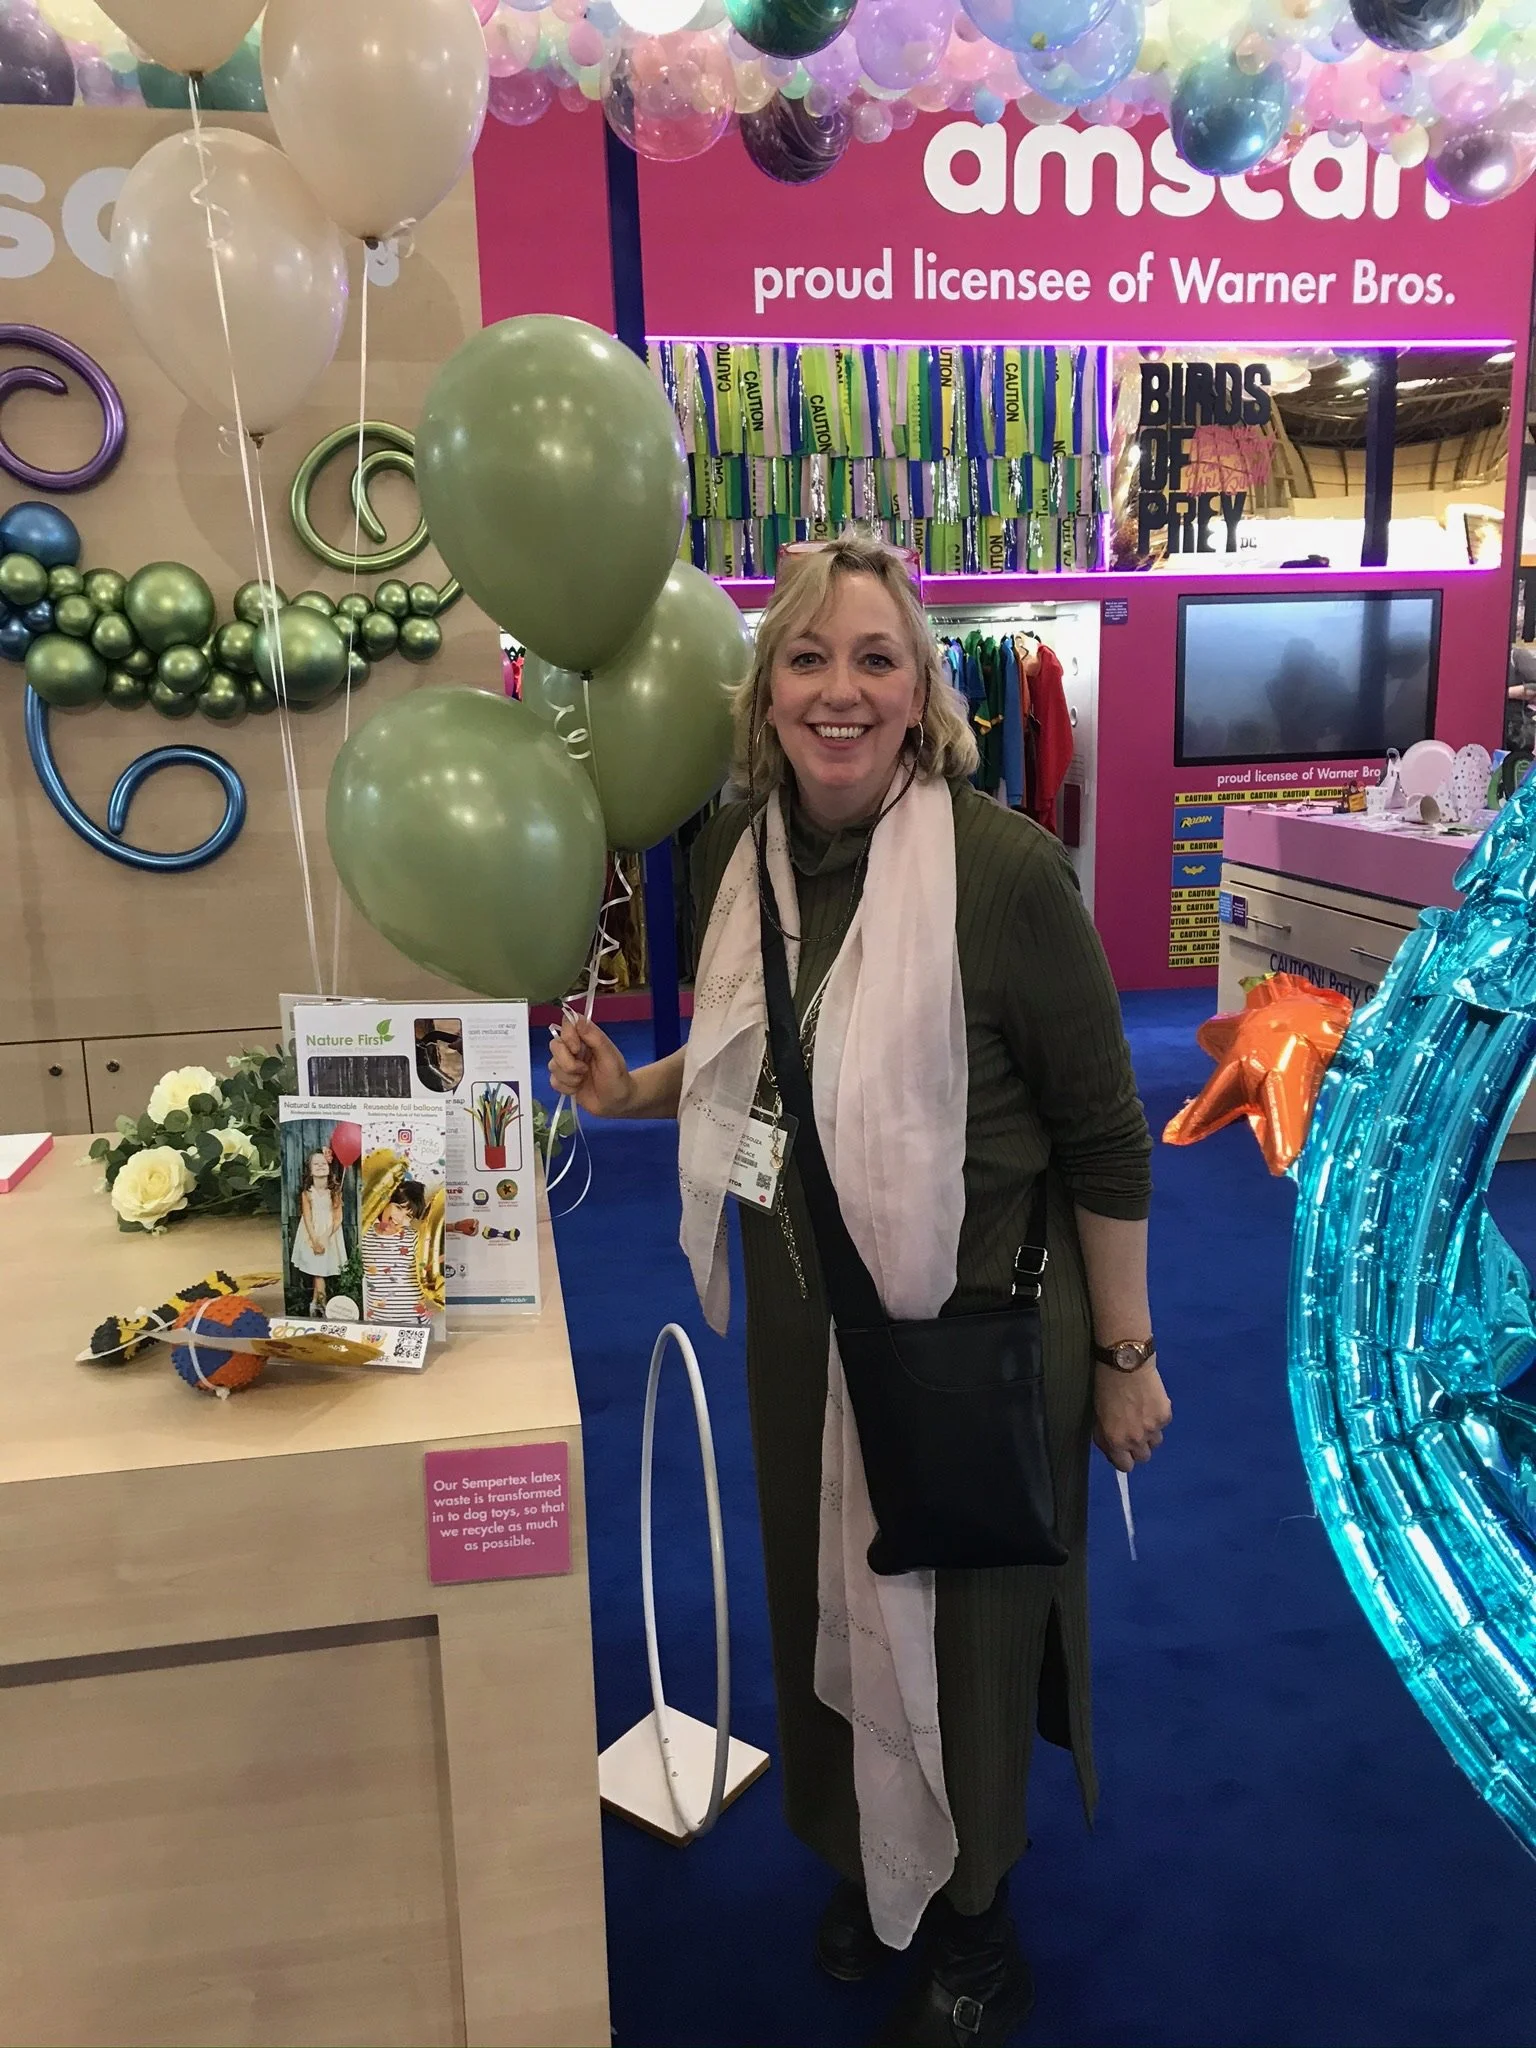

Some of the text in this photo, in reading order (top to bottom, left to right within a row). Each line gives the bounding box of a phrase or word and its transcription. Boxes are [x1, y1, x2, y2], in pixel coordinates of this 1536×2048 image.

[754, 247, 1455, 314] proud licensee of Warner Bros.
[744, 370, 764, 432] CAUTION
[1006, 362, 1020, 423] CAUTION
[1139, 362, 1271, 426] BIRDS
[810, 394, 835, 452] CAUTION
[1139, 427, 1197, 490] OF
[1137, 491, 1247, 555] PREY
[1217, 769, 1251, 787] proud
[1255, 768, 1299, 783] licensee
[1302, 767, 1314, 781] of
[1317, 766, 1358, 780] Warner
[1184, 794, 1213, 803] CAUTION
[1217, 792, 1246, 801] CAUTION
[1250, 791, 1278, 800] CAUTION
[1282, 790, 1310, 799] CAUTION
[1314, 789, 1341, 798] CAUTION
[1180, 815, 1213, 829] ROBIN
[1190, 841, 1218, 850] CAUTION
[1187, 889, 1216, 898] CAUTION
[1186, 903, 1214, 911] CAUTION
[1194, 916, 1220, 924] CAUTIO
[1180, 930, 1208, 939] CAUTION
[1192, 942, 1220, 952] CAUTION
[1270, 953, 1325, 989] CAUTION!
[1329, 972, 1360, 1009] Party
[306, 1033, 385, 1047] Nature First
[284, 1101, 357, 1111] Natural & sustainable
[363, 1102, 444, 1112] Reuseable foil balloons
[433, 1471, 561, 1492] Our Sempertex latex
[434, 1485, 562, 1507] waste is transformed
[432, 1501, 566, 1523] in to dog toys, so that
[440, 1516, 559, 1538] we recycle as much
[464, 1534, 536, 1552] as possible.
